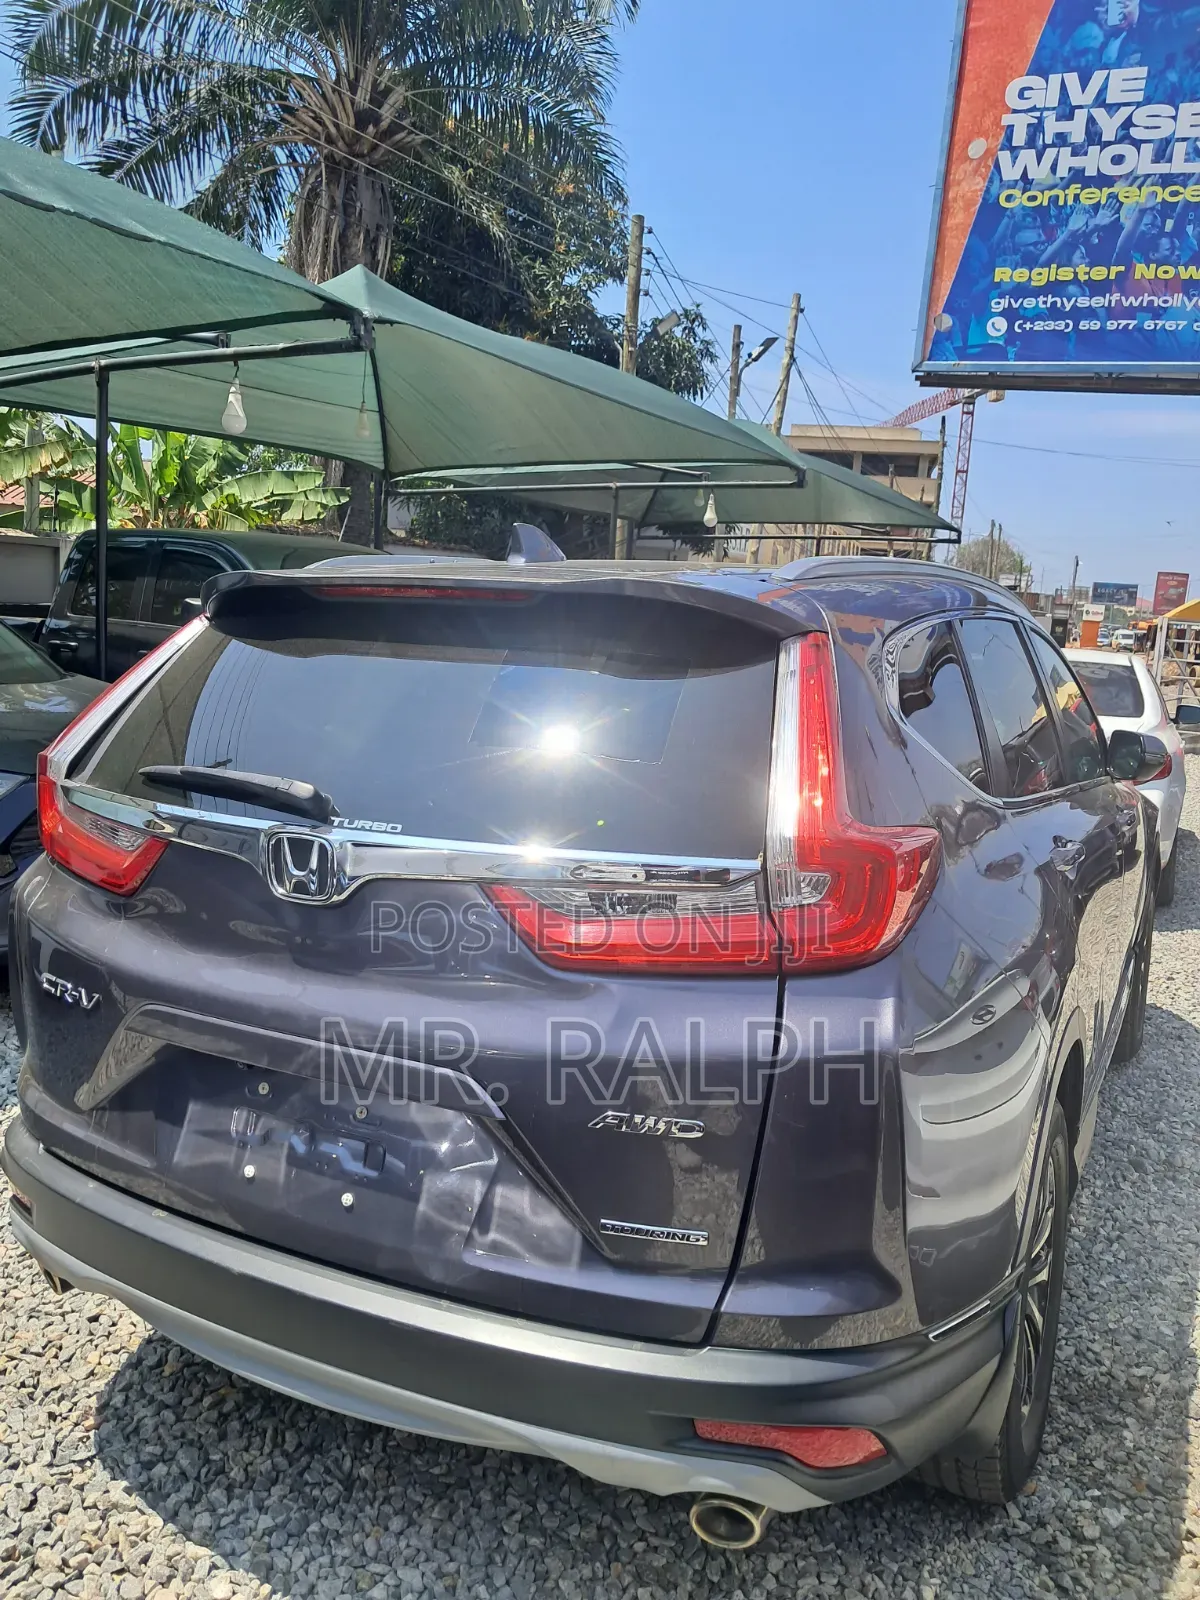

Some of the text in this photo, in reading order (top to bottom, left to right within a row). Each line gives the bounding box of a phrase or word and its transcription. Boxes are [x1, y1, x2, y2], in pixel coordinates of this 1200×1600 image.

[1005, 66, 1148, 110] GIVE
[999, 183, 1200, 209] Conference
[994, 263, 1200, 286] Register Now
[991, 293, 1200, 312] givethyselfwholly
[1014, 320, 1073, 332] (+233)
[1078, 320, 1101, 330] 59
[1106, 320, 1138, 330] 977
[1143, 320, 1187, 331] 6767
[330, 816, 403, 833] TURBO
[40, 972, 100, 1009] CR-V
[588, 1110, 706, 1139] AWD
[605, 1223, 708, 1244] TOURING
